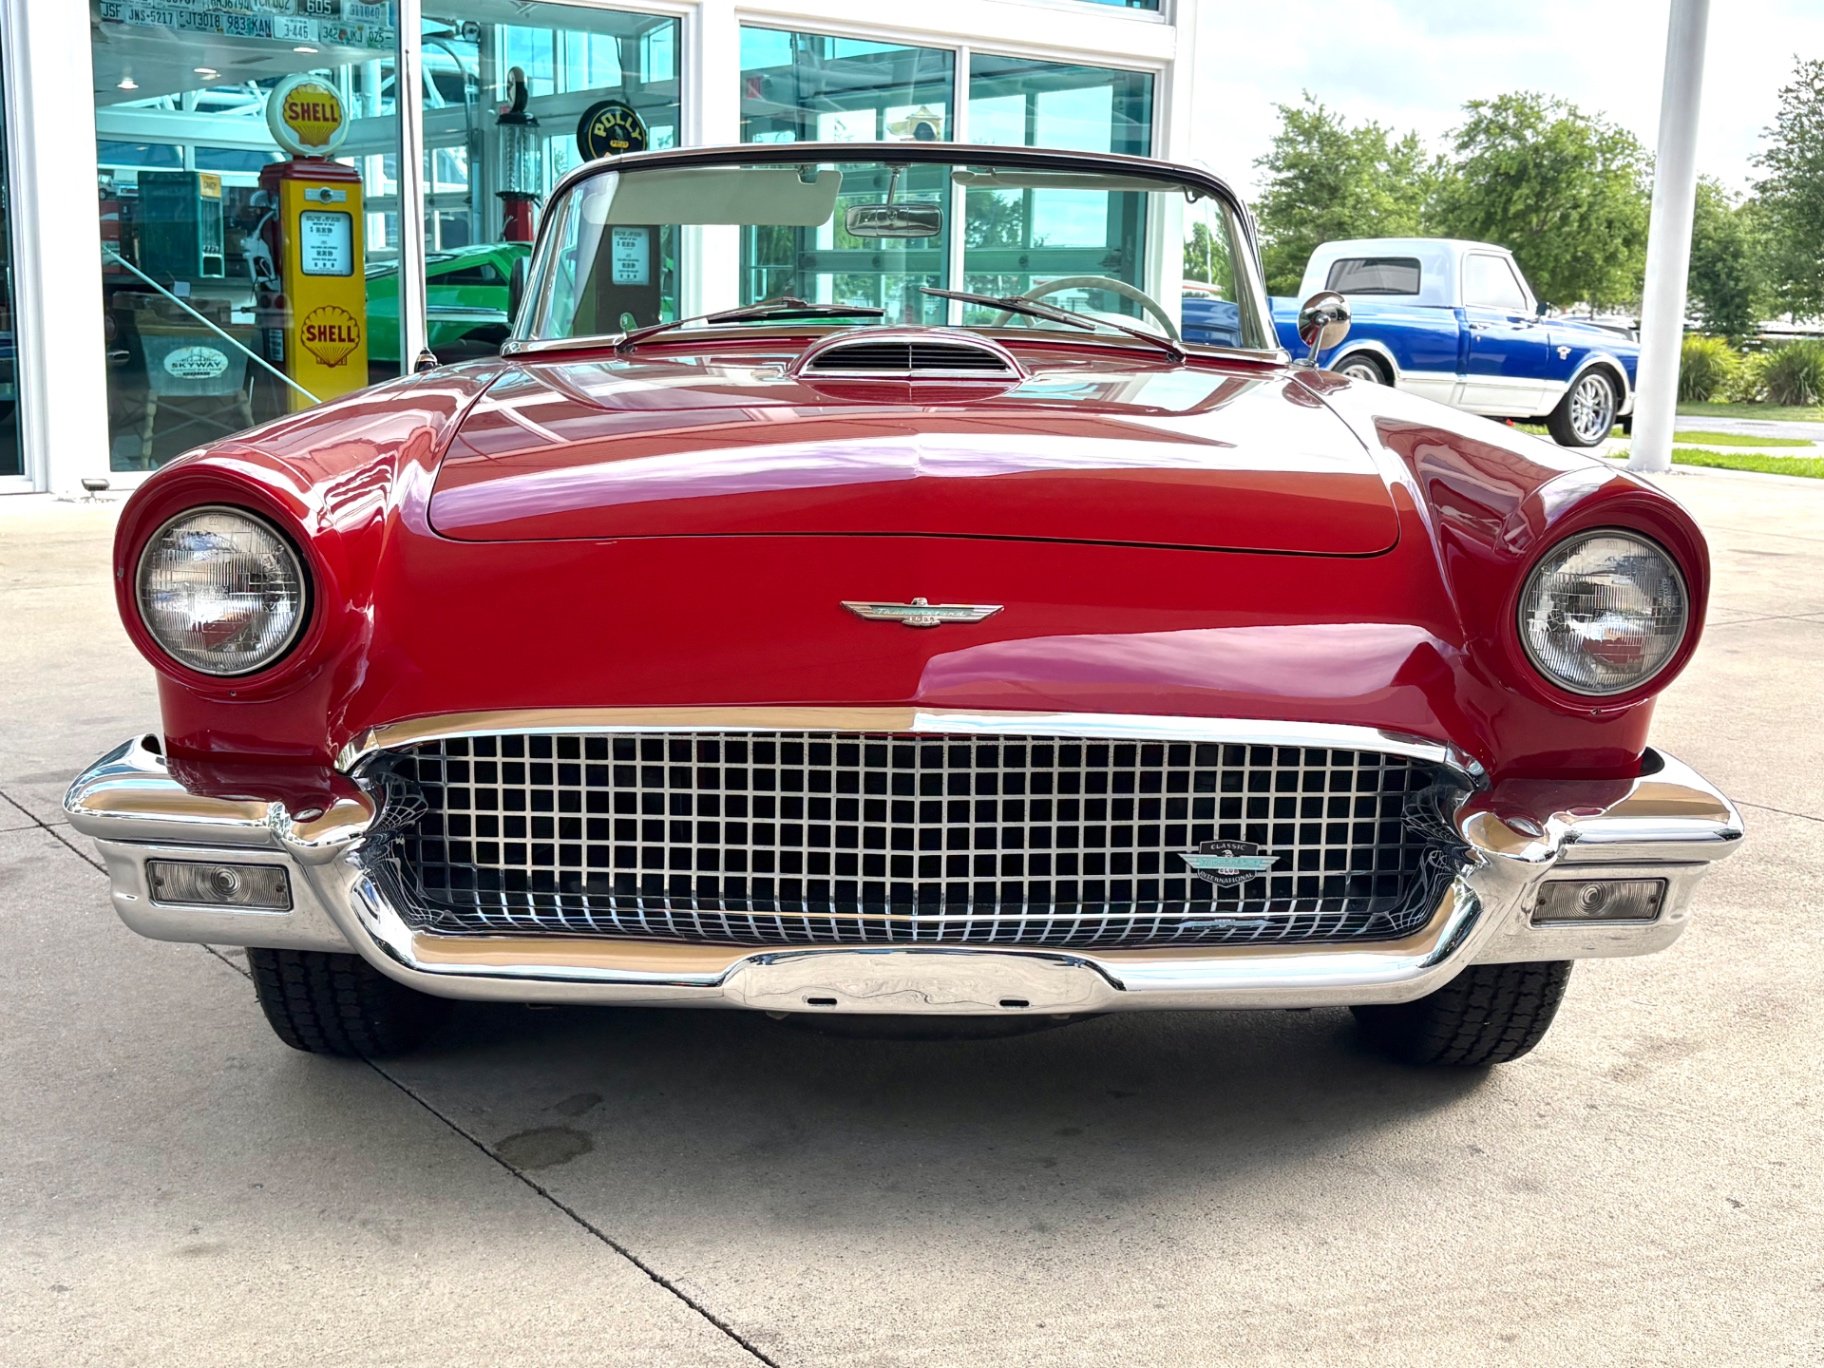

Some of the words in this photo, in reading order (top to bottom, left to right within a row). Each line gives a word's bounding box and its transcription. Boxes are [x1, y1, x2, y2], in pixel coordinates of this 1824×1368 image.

[227, 15, 246, 30] 983
[288, 102, 339, 122] SHELL
[594, 111, 642, 140] POLLY
[306, 324, 356, 343] SHELL
[1210, 843, 1248, 851] CLASSIC
[1199, 870, 1254, 884] INTERNATIONAL
